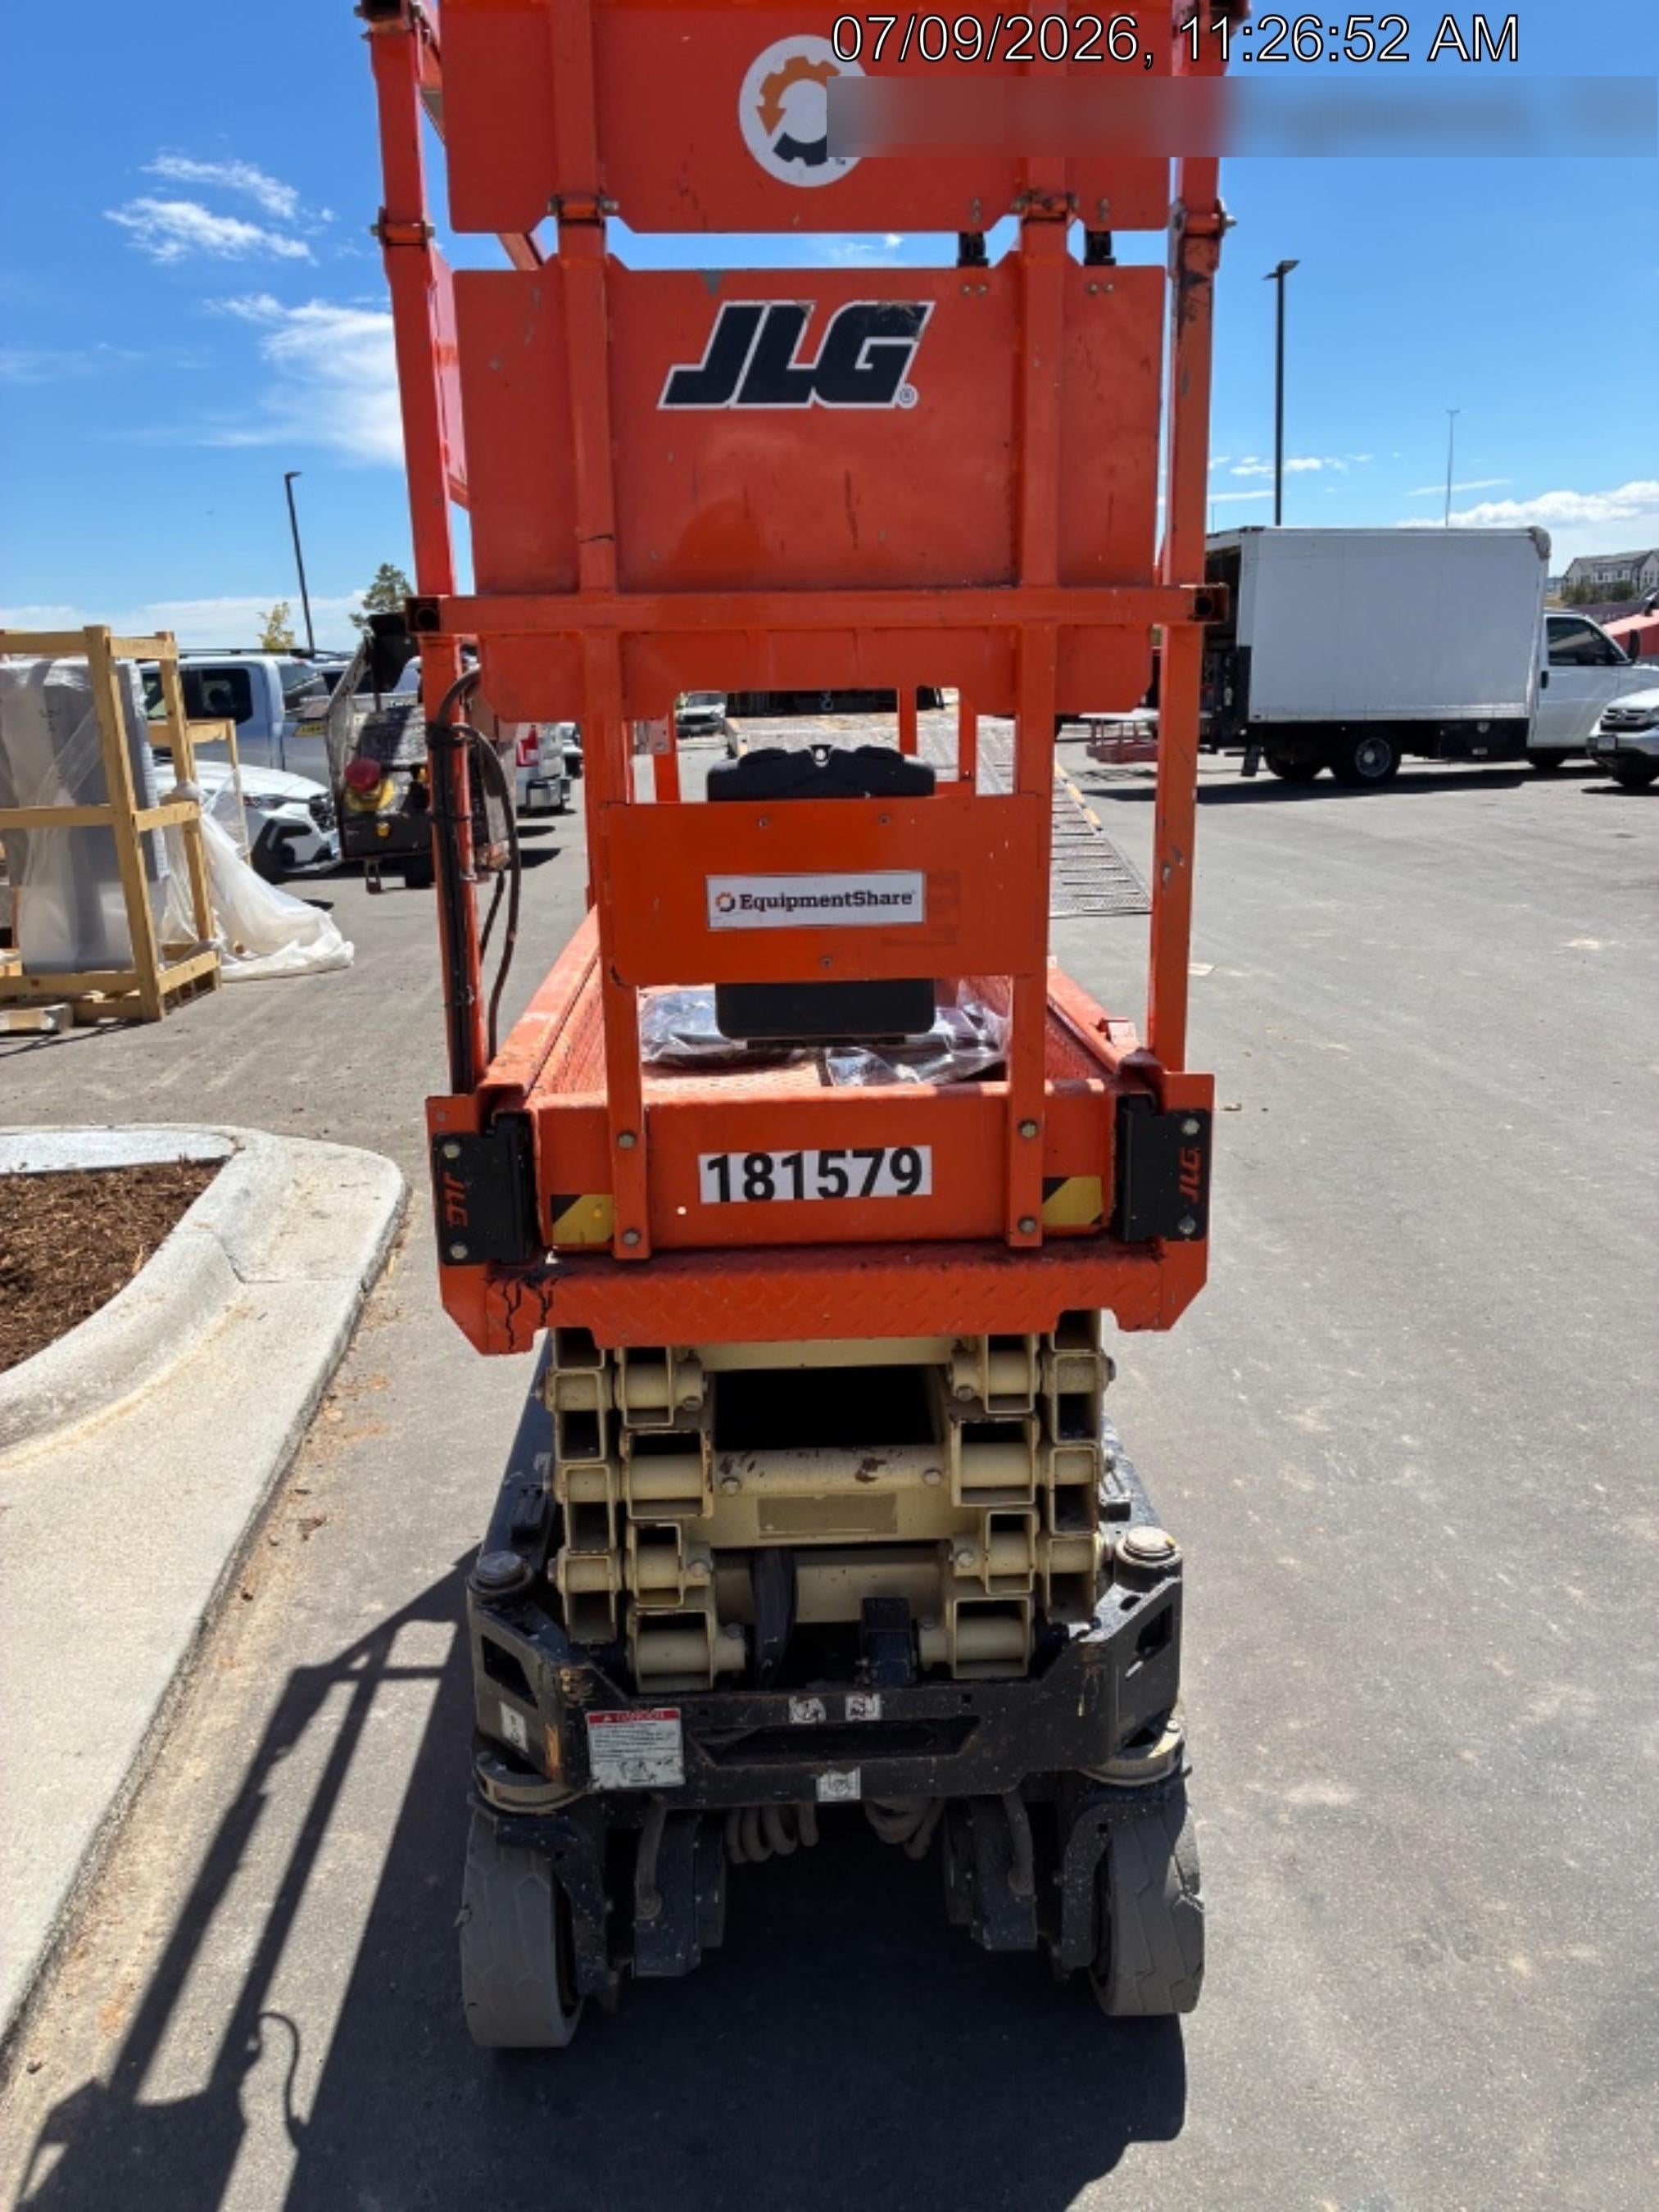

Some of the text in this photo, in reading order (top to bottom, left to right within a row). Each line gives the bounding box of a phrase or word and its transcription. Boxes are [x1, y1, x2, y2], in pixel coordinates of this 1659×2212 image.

[657, 300, 936, 410] JLG
[739, 890, 913, 913] EquipmentShare
[444, 1171, 468, 1227] JLG
[707, 1147, 922, 1203] 181579
[1179, 1148, 1202, 1203] JLG
